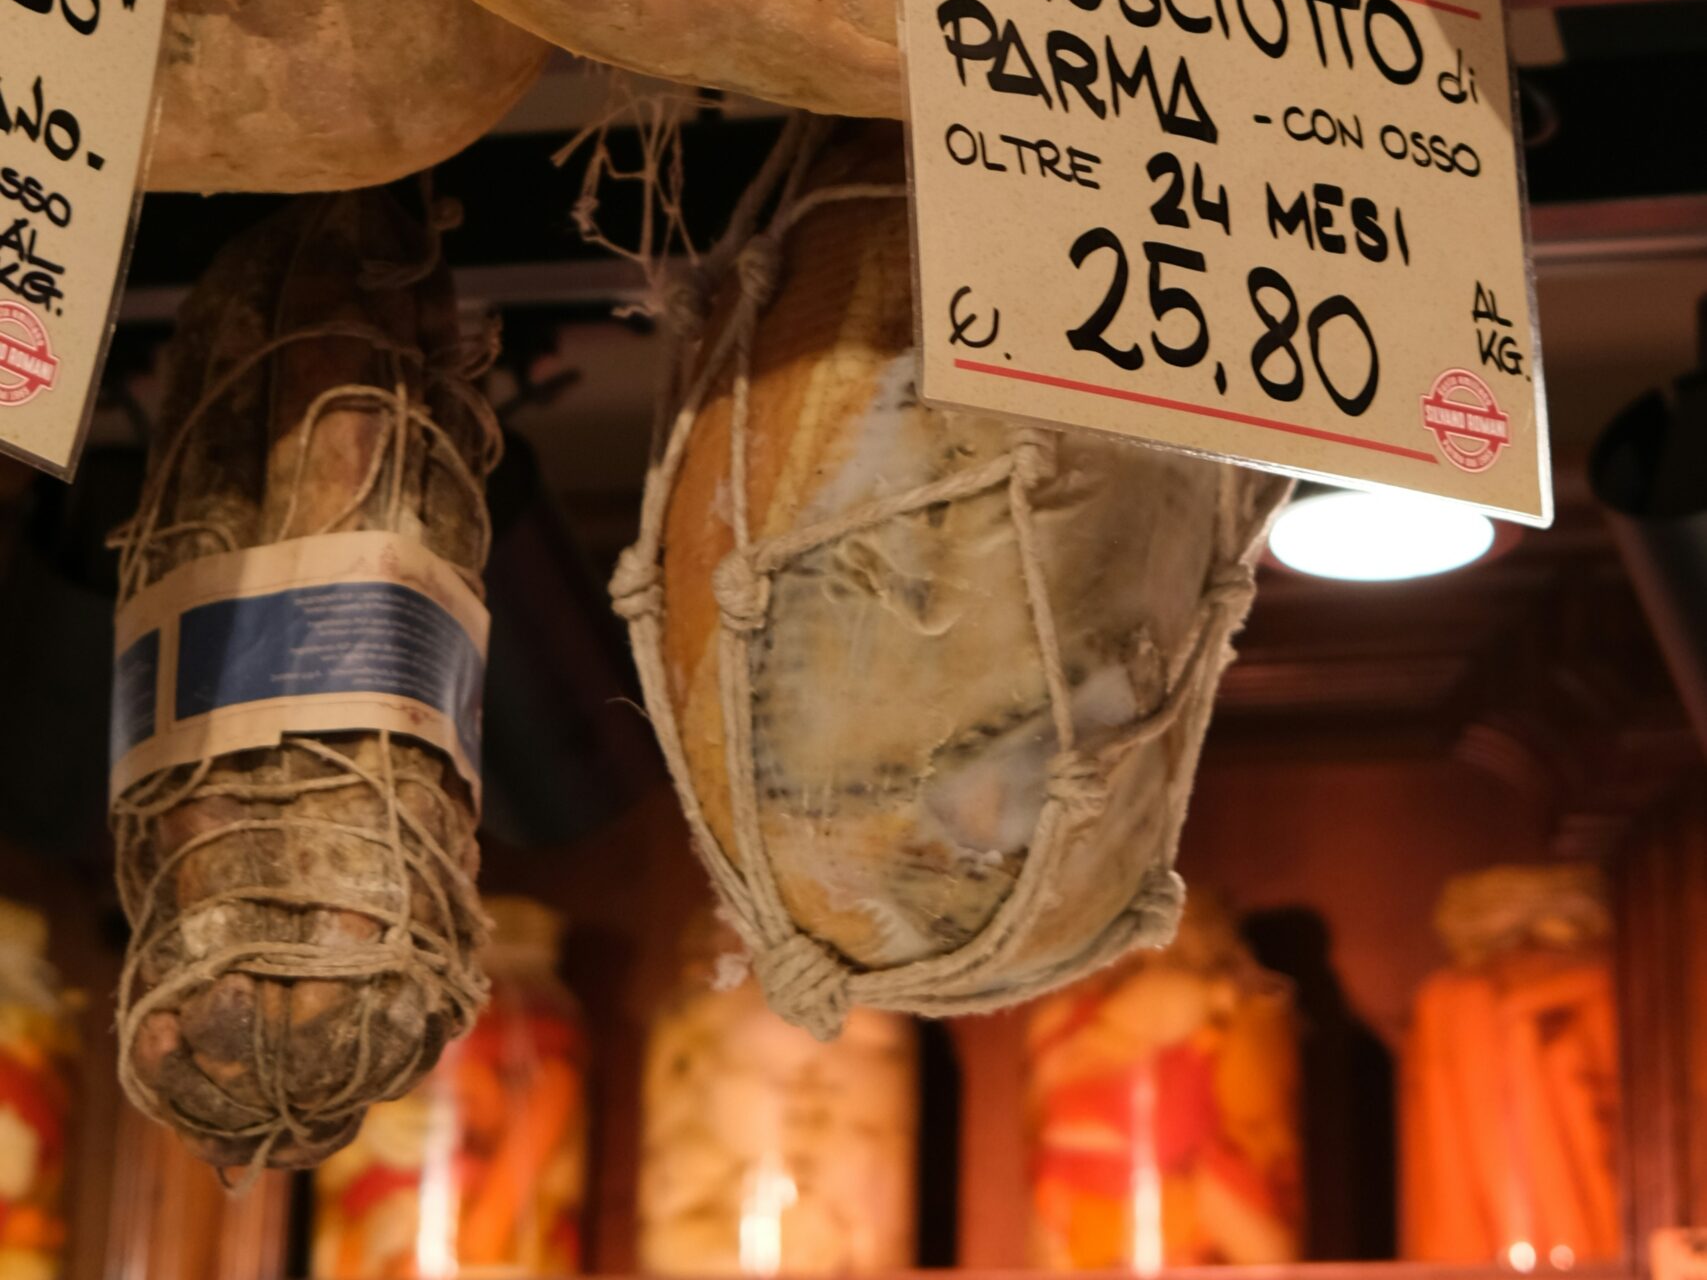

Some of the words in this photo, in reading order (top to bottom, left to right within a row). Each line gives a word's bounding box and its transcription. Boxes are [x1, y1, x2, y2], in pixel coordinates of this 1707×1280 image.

[1436, 48, 1479, 106] di
[1380, 124, 1482, 178] OSSO
[945, 123, 1101, 190] OLTRE
[1146, 151, 1231, 236] 24
[1265, 183, 1410, 266] MESI
[1066, 227, 1380, 417] 25,80
[1472, 282, 1513, 328] AL
